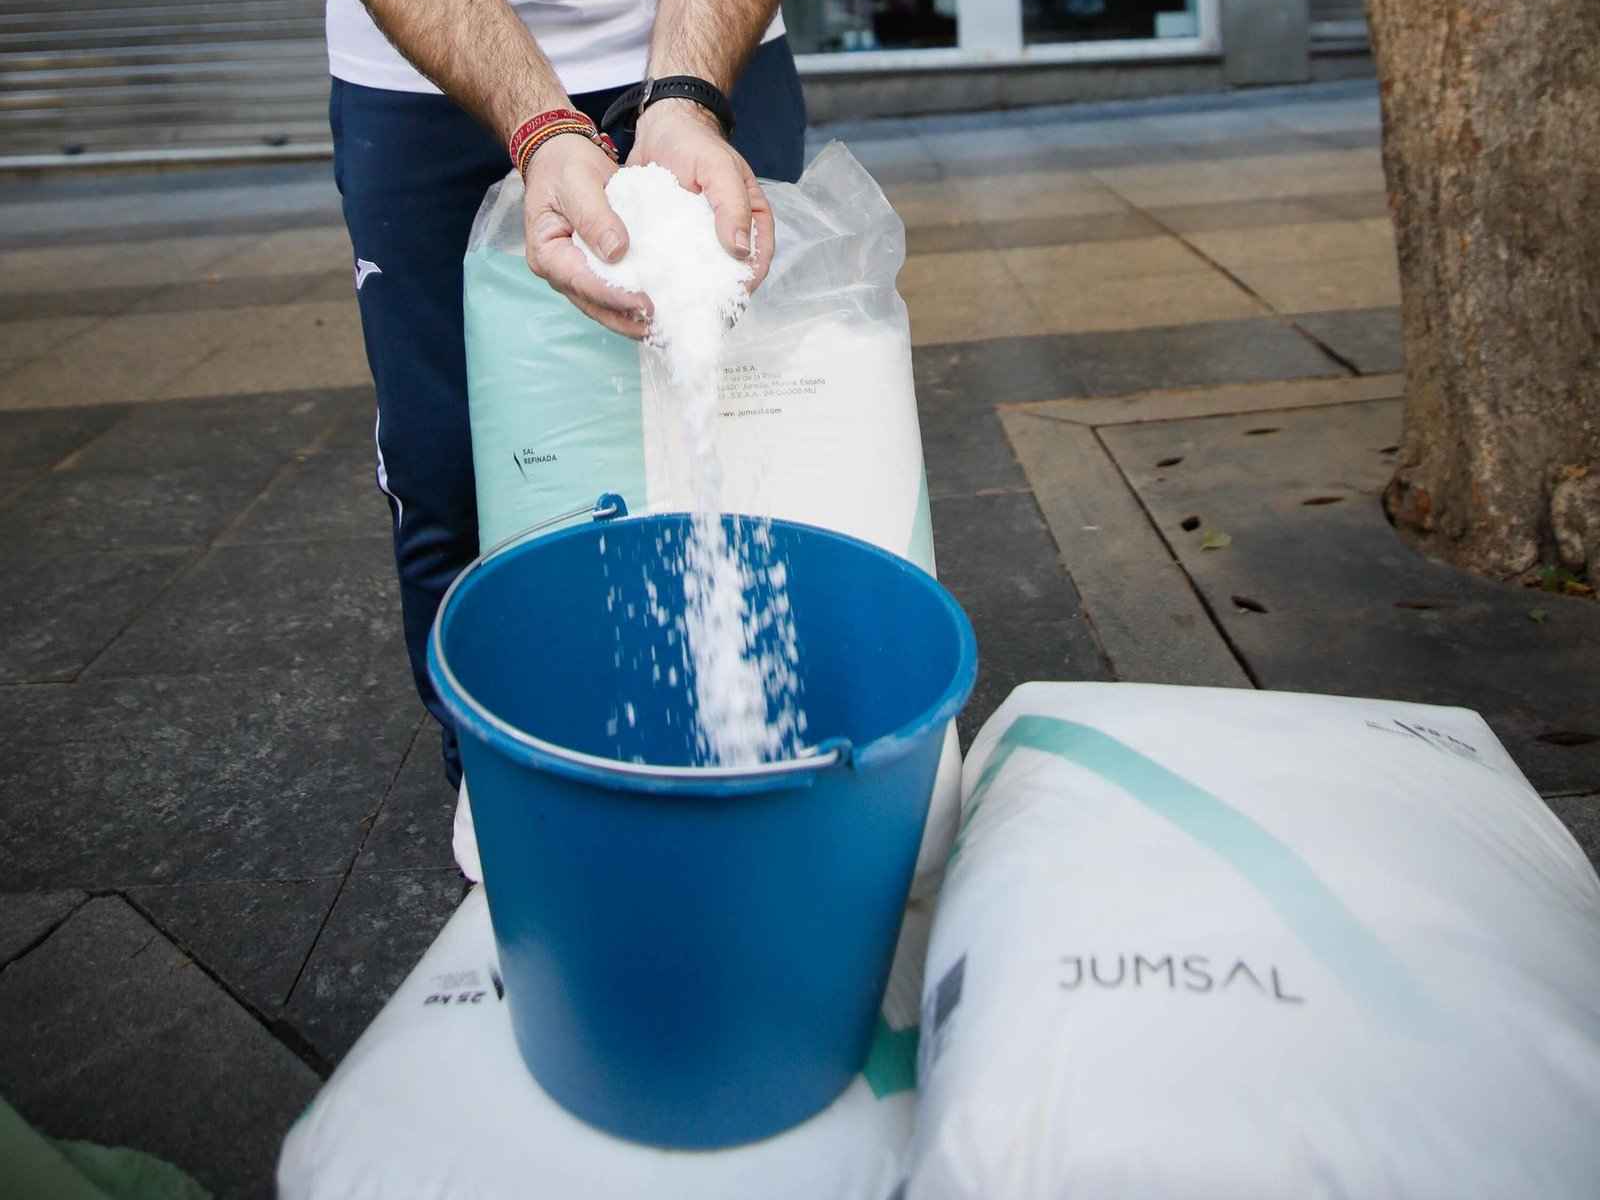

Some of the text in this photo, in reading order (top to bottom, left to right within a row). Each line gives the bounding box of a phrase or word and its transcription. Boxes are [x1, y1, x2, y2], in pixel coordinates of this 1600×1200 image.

[742, 364, 758, 373] S.A.
[800, 377, 826, 387] España
[522, 448, 535, 456] SAL
[523, 454, 557, 465] REFINADA
[1058, 952, 1305, 1005] JUMSAL
